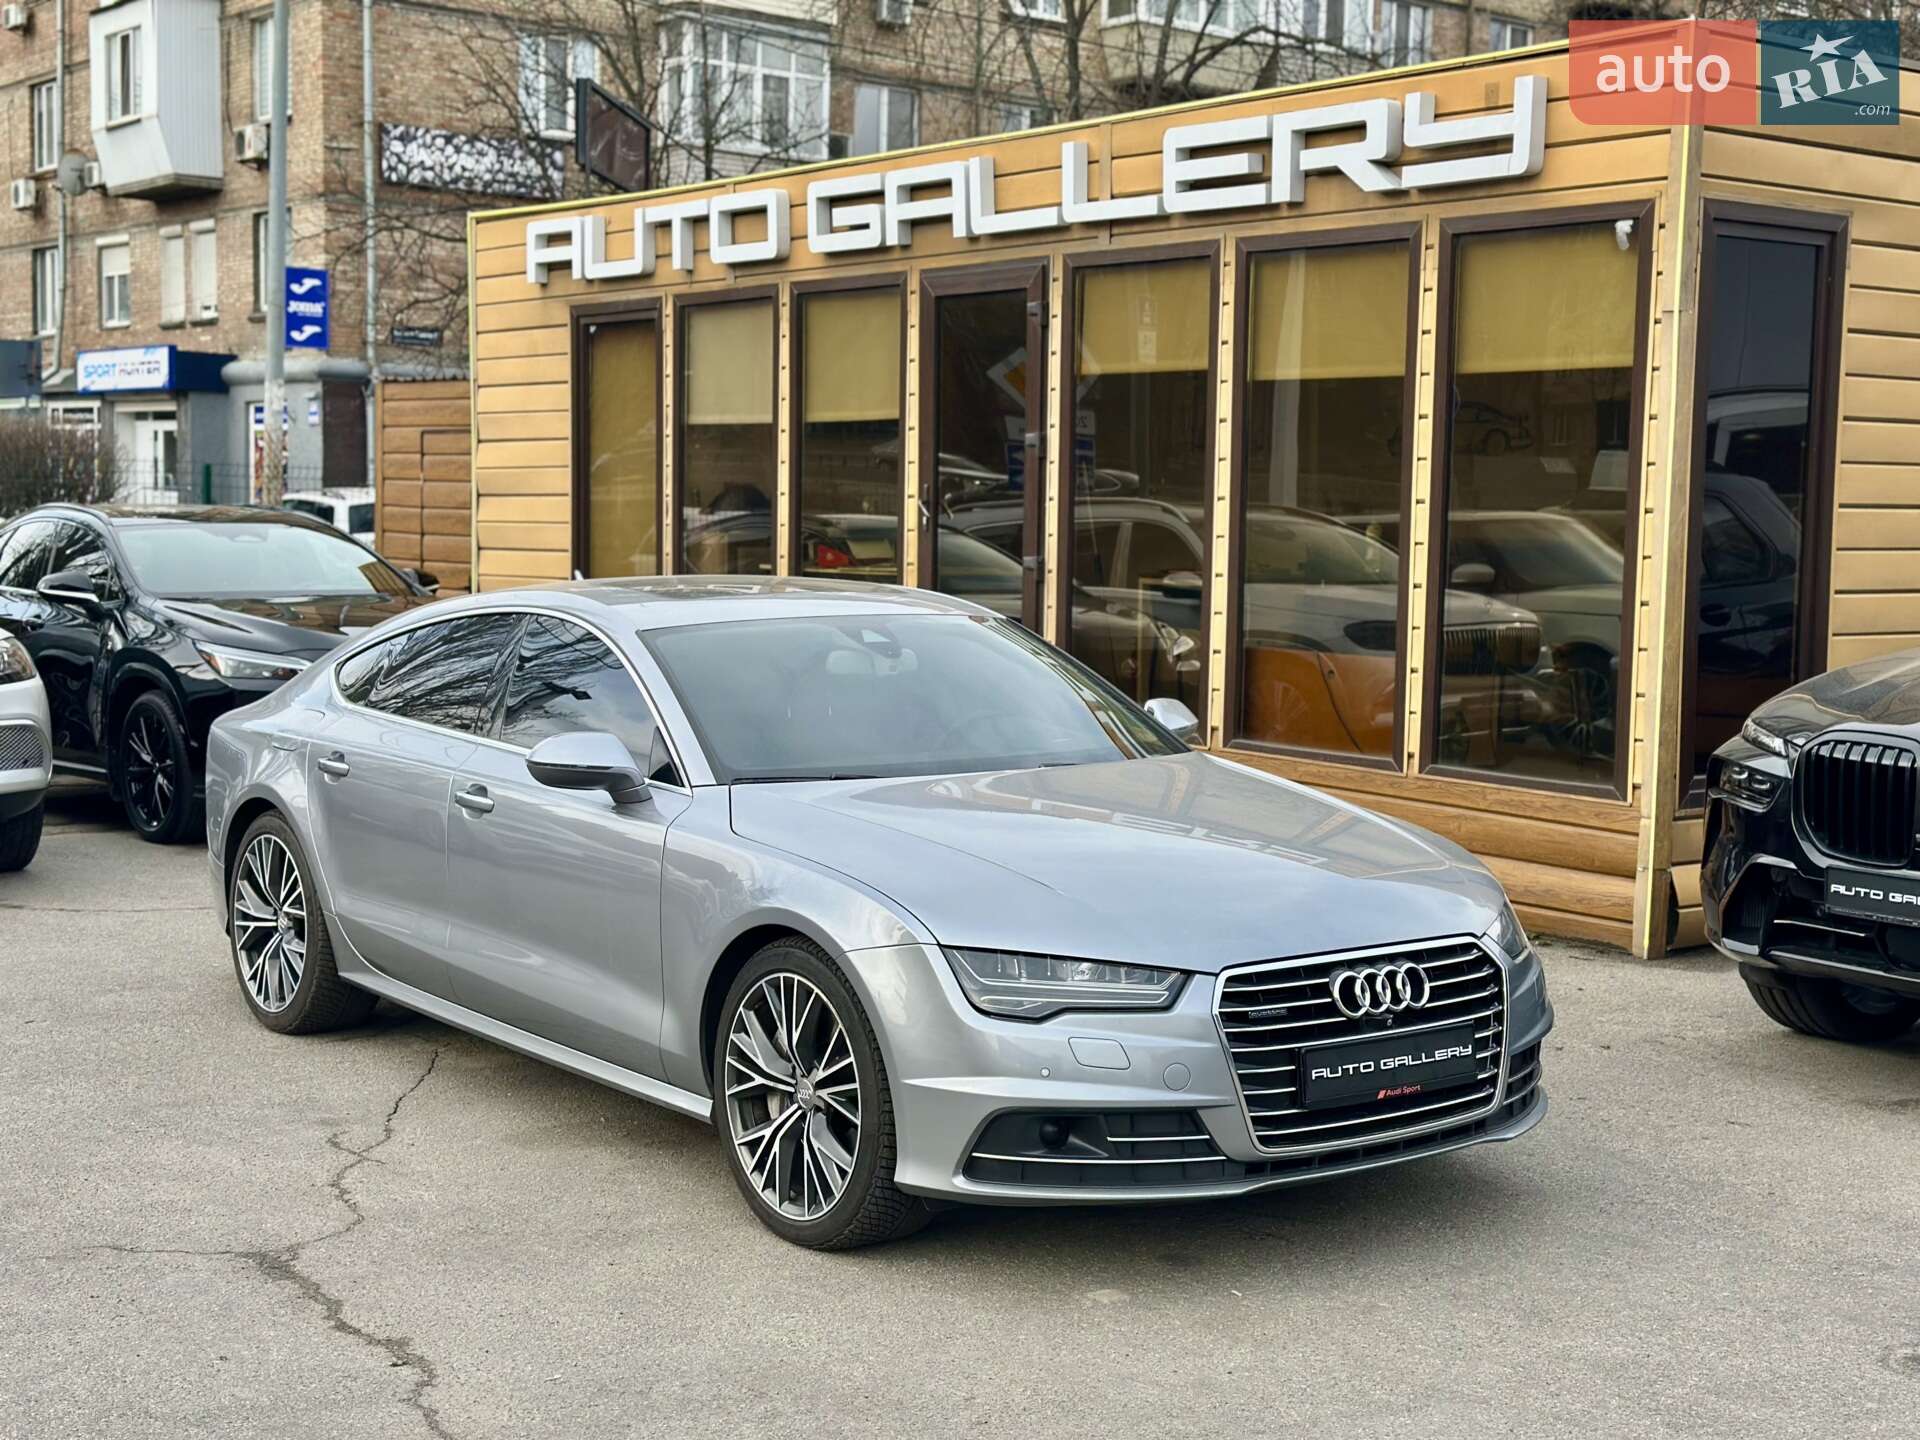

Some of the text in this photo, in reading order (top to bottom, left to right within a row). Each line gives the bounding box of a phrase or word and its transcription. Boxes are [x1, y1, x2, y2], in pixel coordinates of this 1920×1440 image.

[526, 74, 1549, 284] AUTO GALLERY
[84, 362, 117, 379] SPORT
[1830, 883, 1920, 906] AUTO GA
[1311, 1044, 1473, 1081] AUTO GALLERY
[1386, 1084, 1422, 1097] Audi Sport
